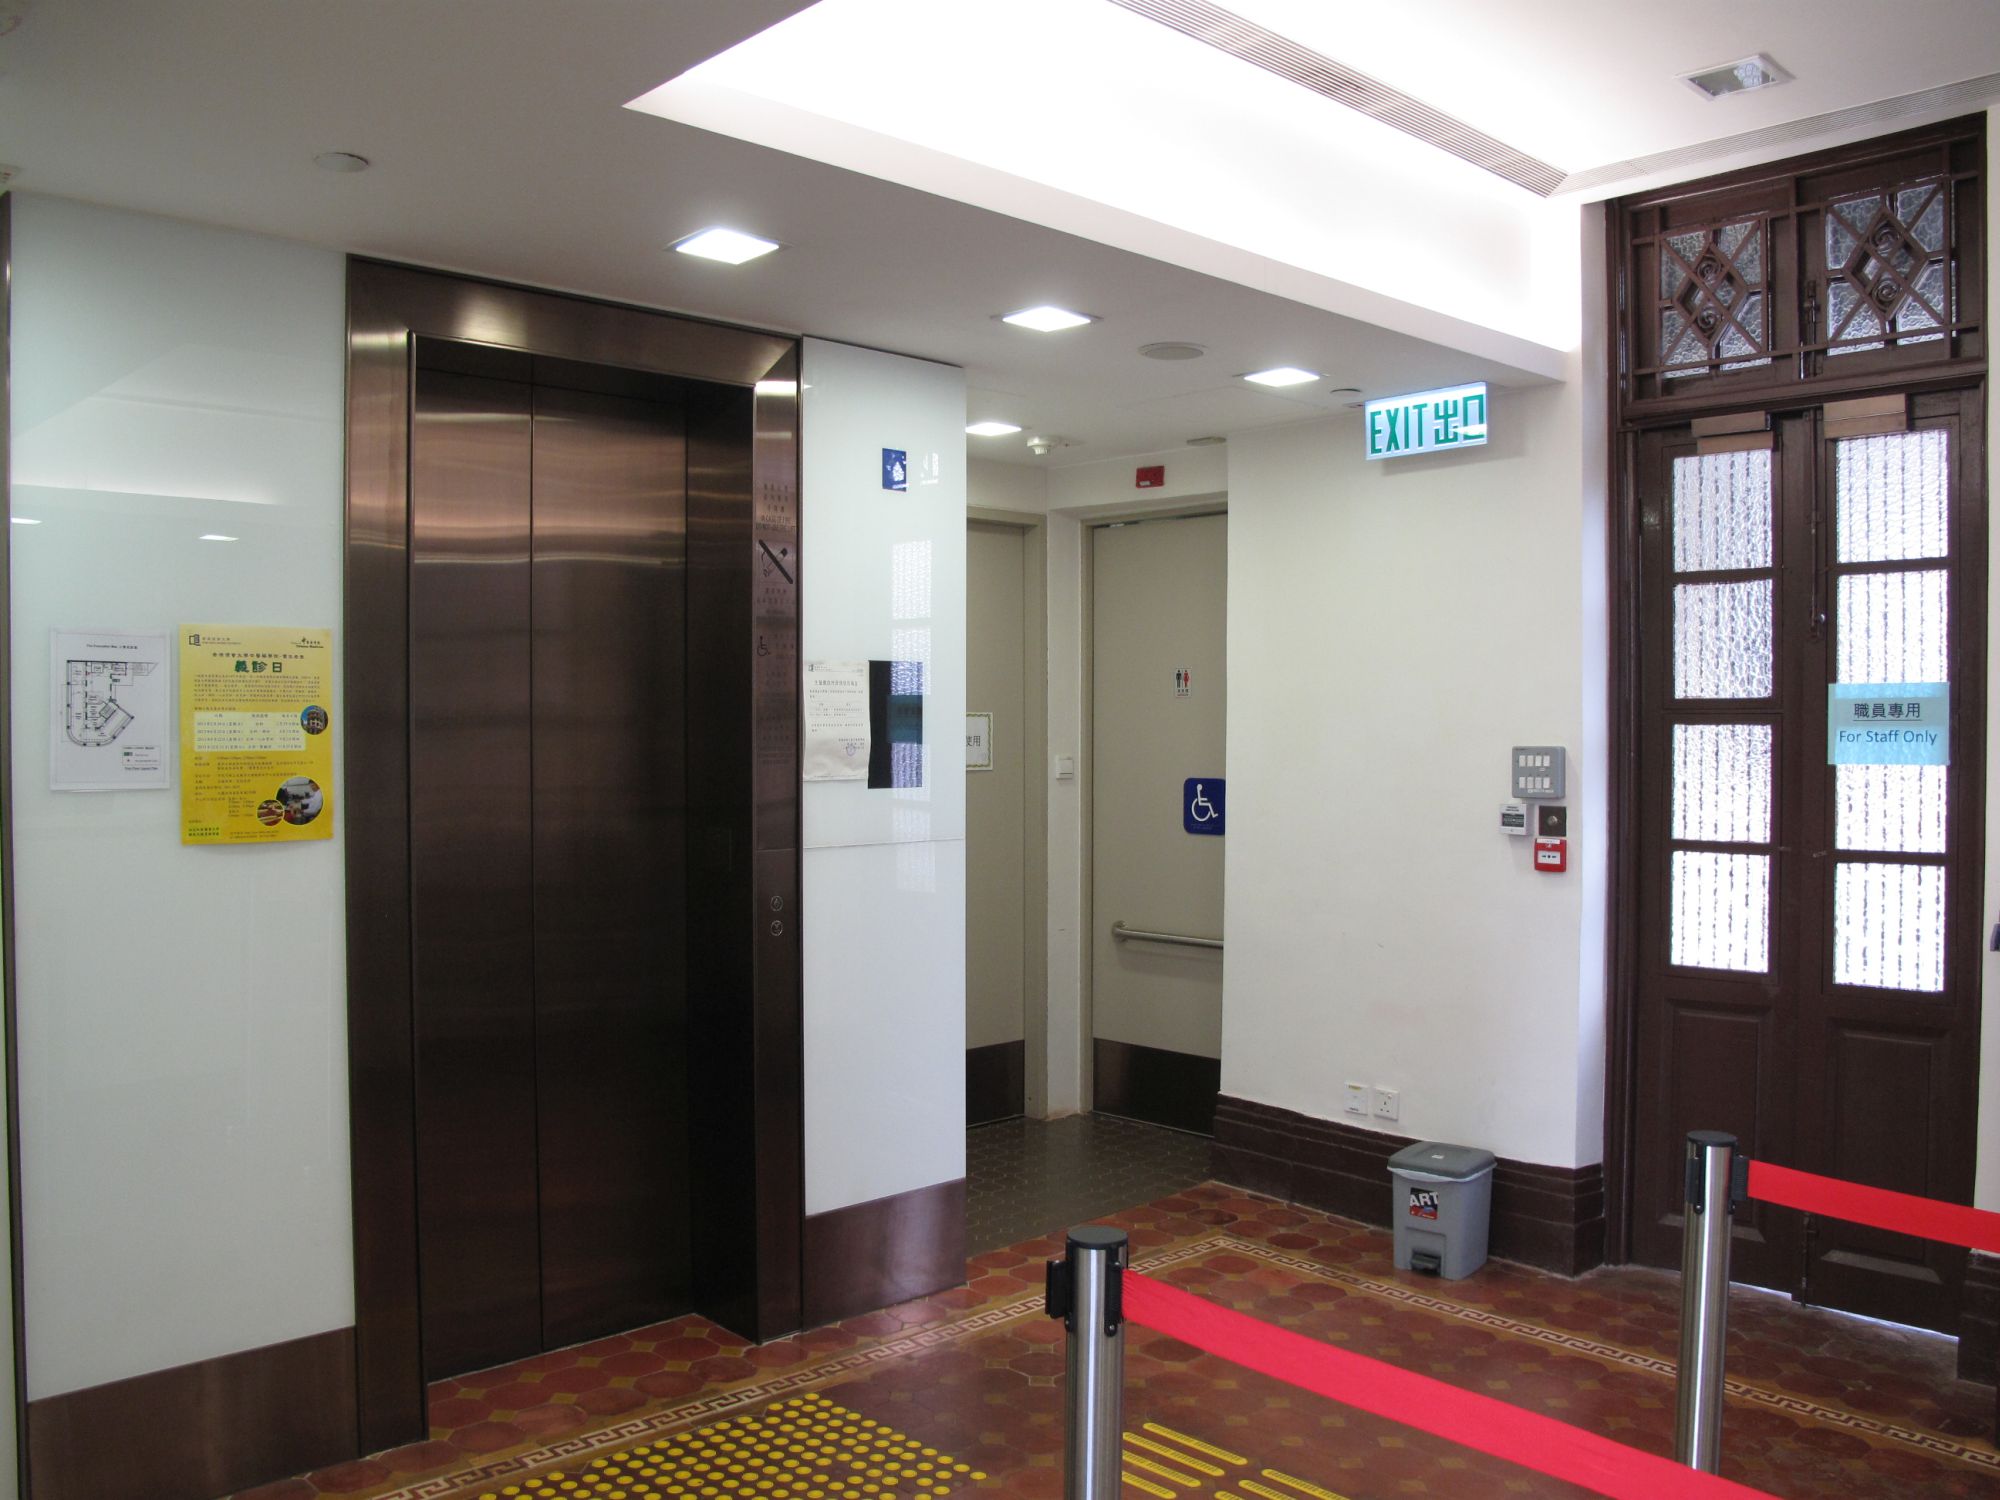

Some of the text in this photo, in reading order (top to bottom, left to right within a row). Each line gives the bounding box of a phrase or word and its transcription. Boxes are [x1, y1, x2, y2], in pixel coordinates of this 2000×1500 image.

[1370, 395, 1484, 455] EXIT 出口
[1853, 703, 1921, 718] 職員專用
[1839, 730, 1938, 746] For Staff Only
[1410, 1191, 1439, 1207] ART
